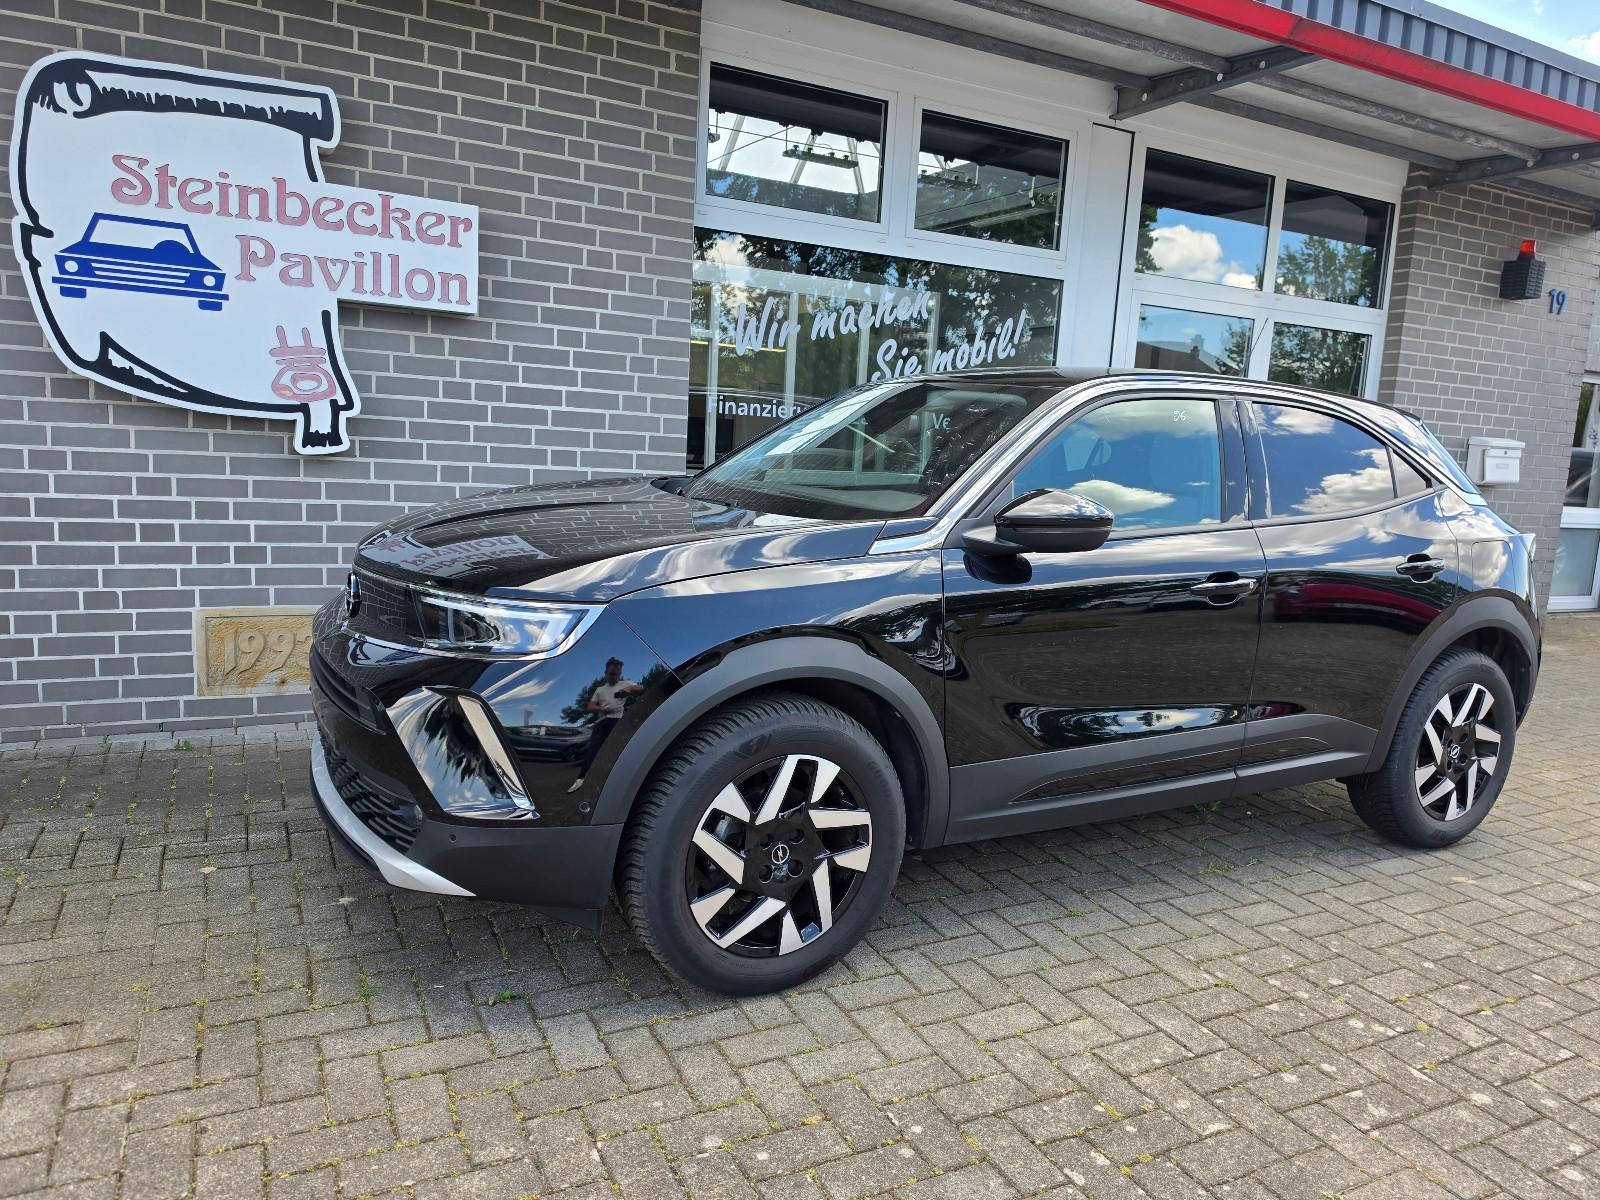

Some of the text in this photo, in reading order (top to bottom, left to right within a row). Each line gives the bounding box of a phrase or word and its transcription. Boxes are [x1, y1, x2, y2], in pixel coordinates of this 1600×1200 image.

[111, 154, 473, 249] Steinbecker
[234, 234, 471, 306] Pavillon
[1548, 287, 1568, 316] 19
[735, 288, 931, 356] Wir machen
[871, 308, 1027, 383] Sie mobil!
